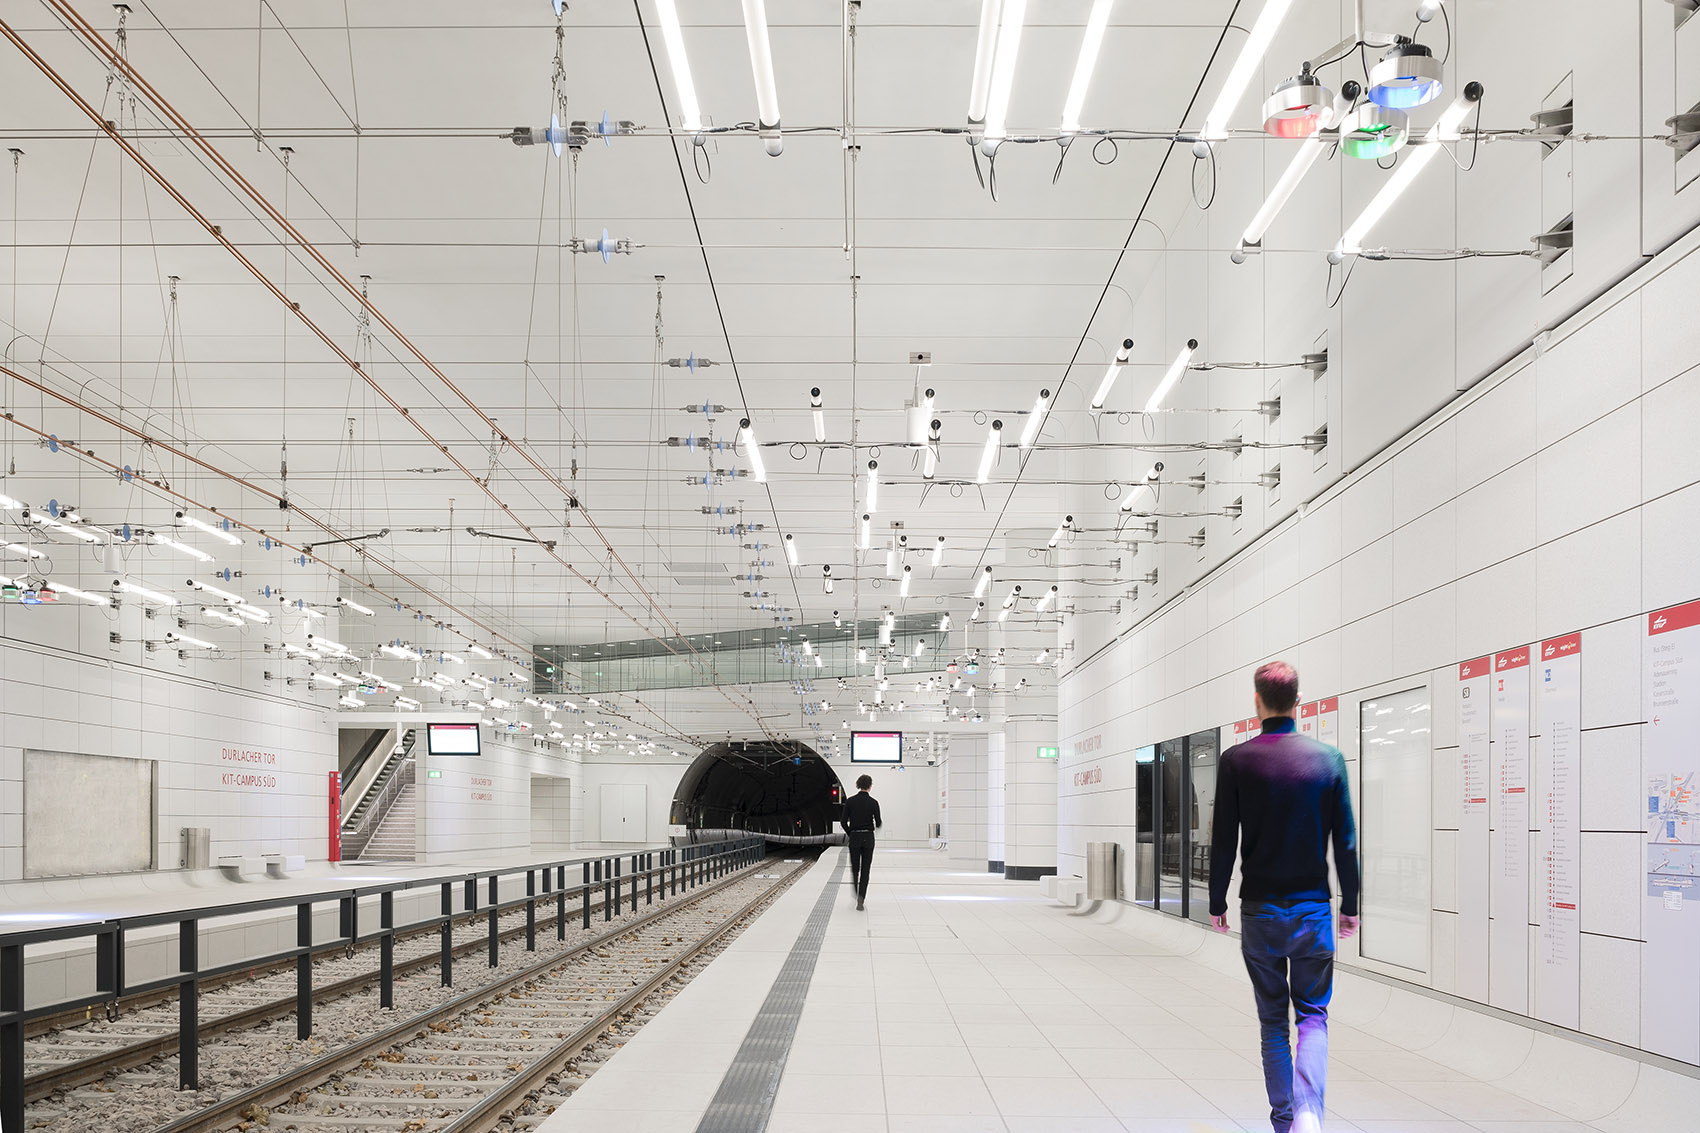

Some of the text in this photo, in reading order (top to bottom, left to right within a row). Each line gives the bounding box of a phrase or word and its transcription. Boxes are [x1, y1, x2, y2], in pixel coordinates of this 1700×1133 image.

[222, 748, 276, 765] DURLACHER TOR
[222, 773, 276, 787] KIT-CAMPUS SÜD
